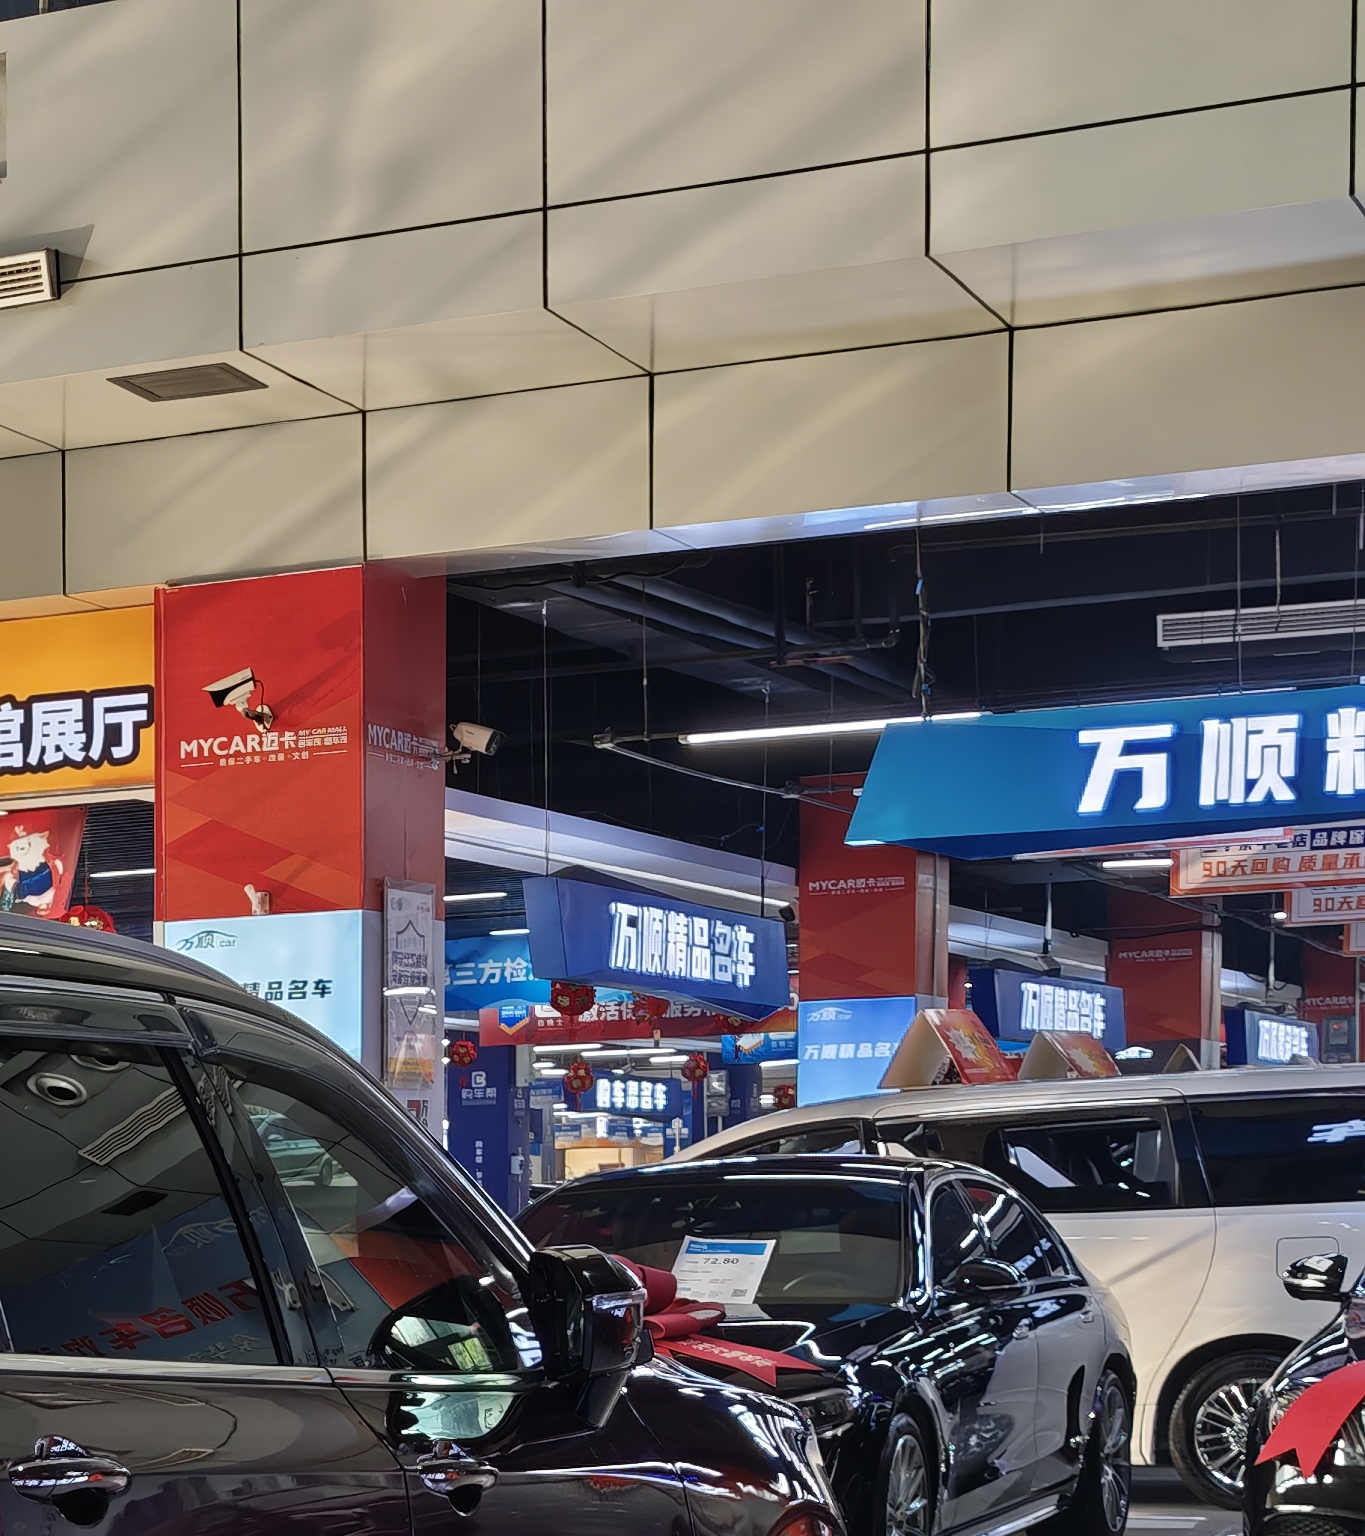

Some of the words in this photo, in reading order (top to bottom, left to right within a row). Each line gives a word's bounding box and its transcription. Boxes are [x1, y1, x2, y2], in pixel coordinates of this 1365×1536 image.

[1298, 852, 1365, 873] 质量承
[609, 901, 756, 989] 万顺精品名车
[445, 956, 539, 987] 三方检
